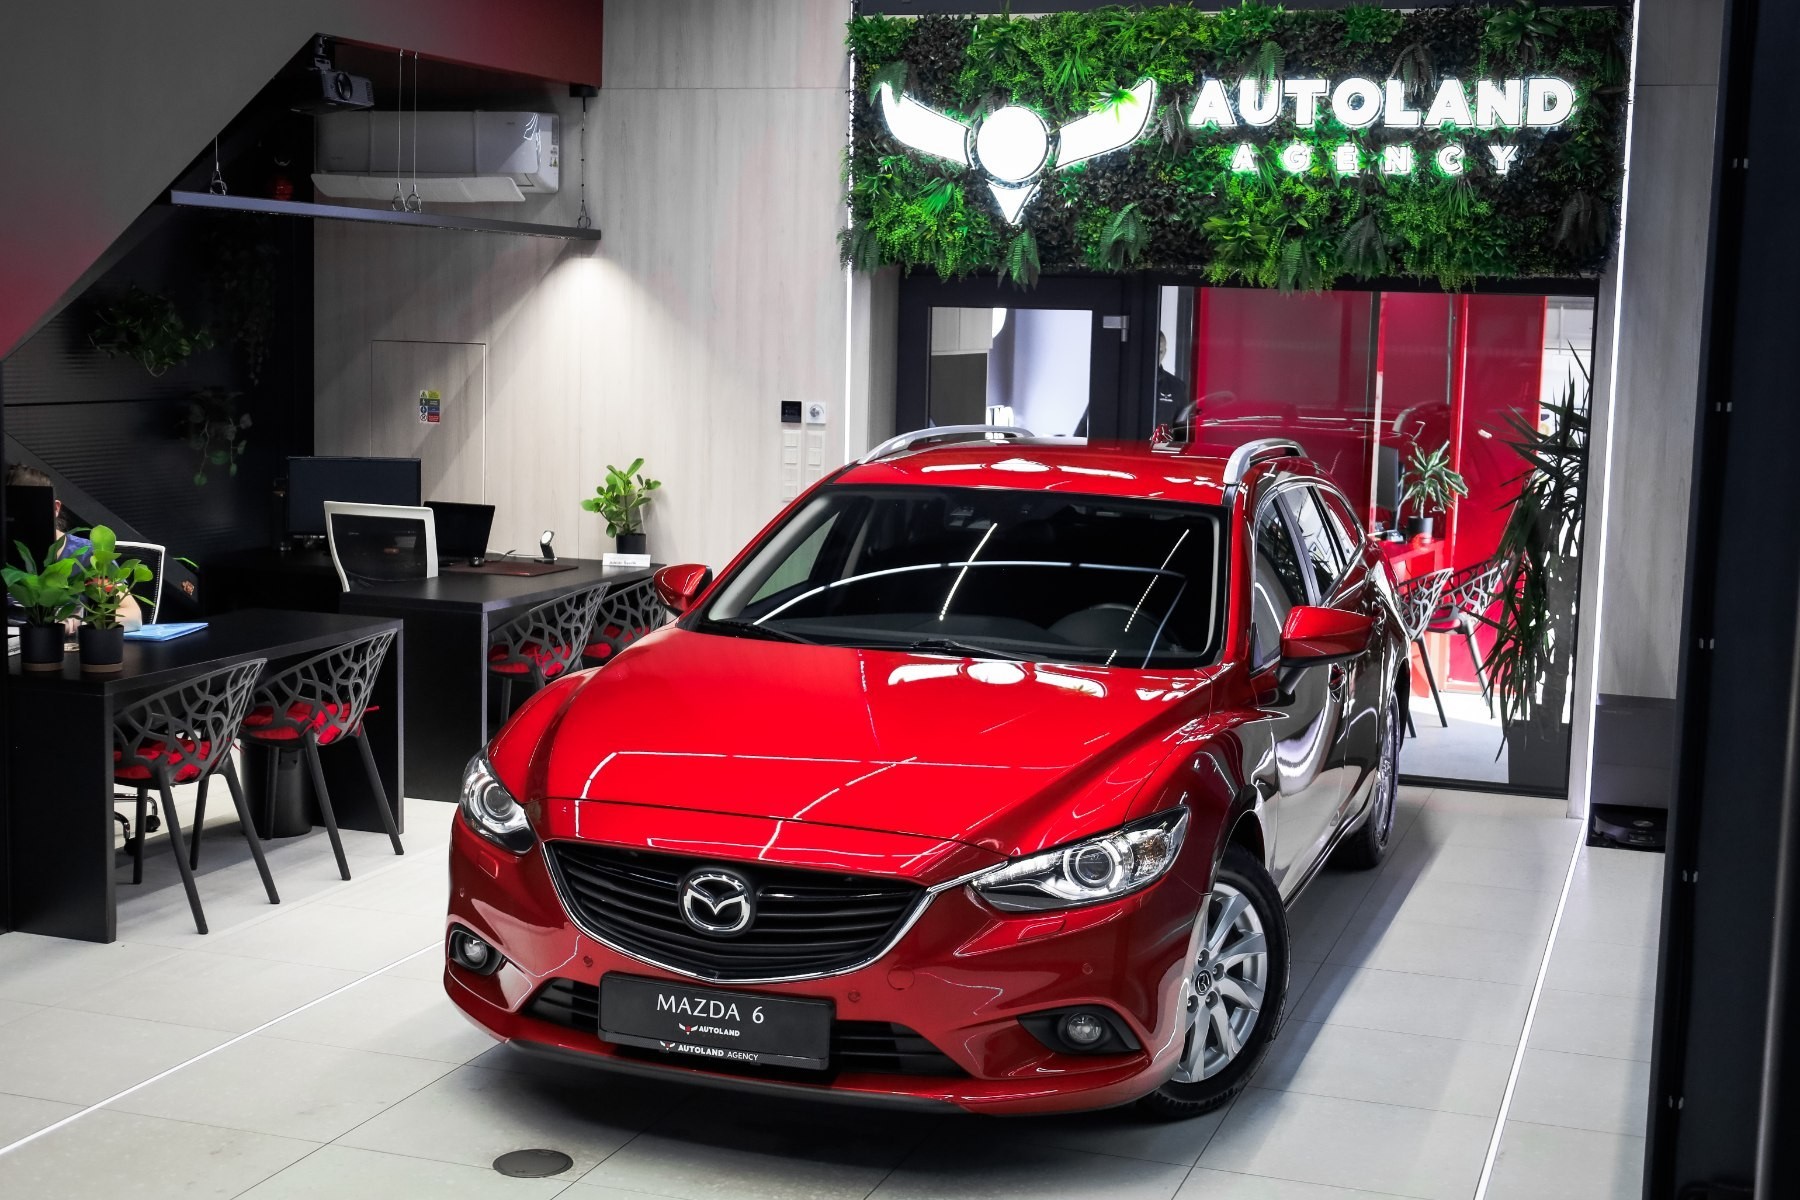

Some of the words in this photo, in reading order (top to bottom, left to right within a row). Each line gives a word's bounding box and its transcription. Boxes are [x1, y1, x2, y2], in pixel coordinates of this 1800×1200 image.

[1188, 78, 1576, 127] AUTOLAND
[1231, 143, 1517, 175] AGENCY
[657, 994, 740, 1021] MAZDA
[752, 1006, 764, 1024] 6
[698, 1025, 740, 1037] AUTOLAND
[678, 1044, 724, 1057] AUTOLAND
[727, 1051, 759, 1061] AGENCY
